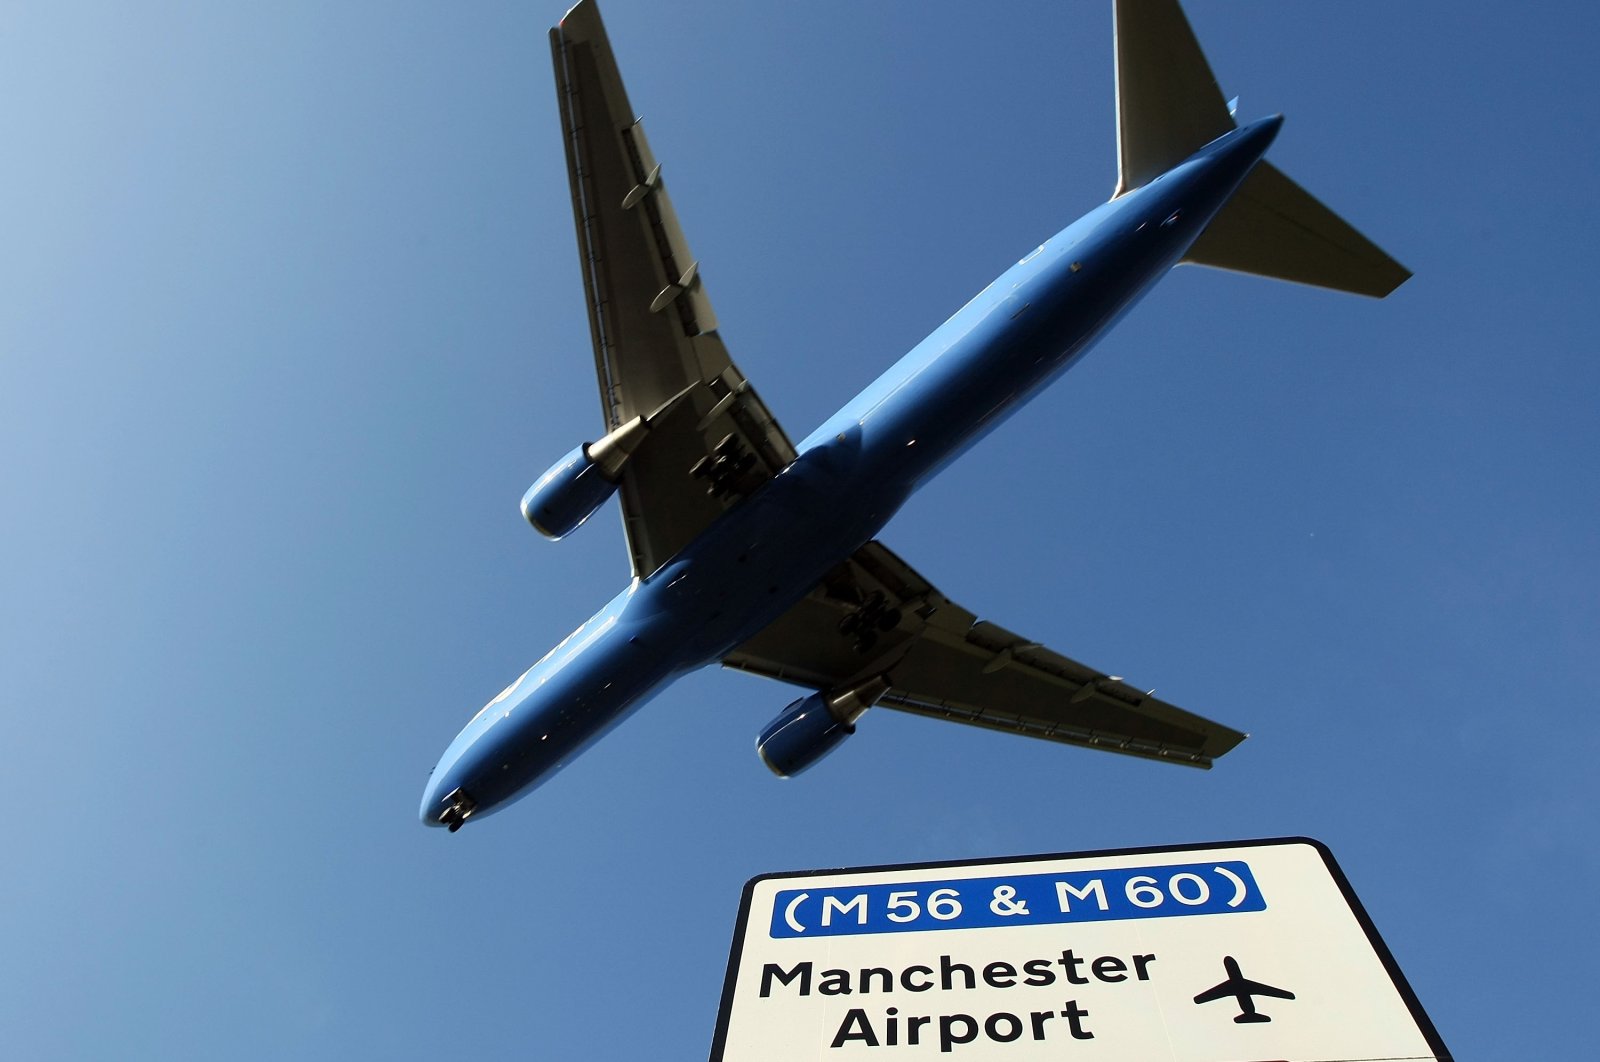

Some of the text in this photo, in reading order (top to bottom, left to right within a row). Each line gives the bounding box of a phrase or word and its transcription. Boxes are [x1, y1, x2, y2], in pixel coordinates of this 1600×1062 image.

[989, 885, 1030, 916] &
[759, 949, 1156, 998] Manchester
[830, 999, 1095, 1053] Airport
